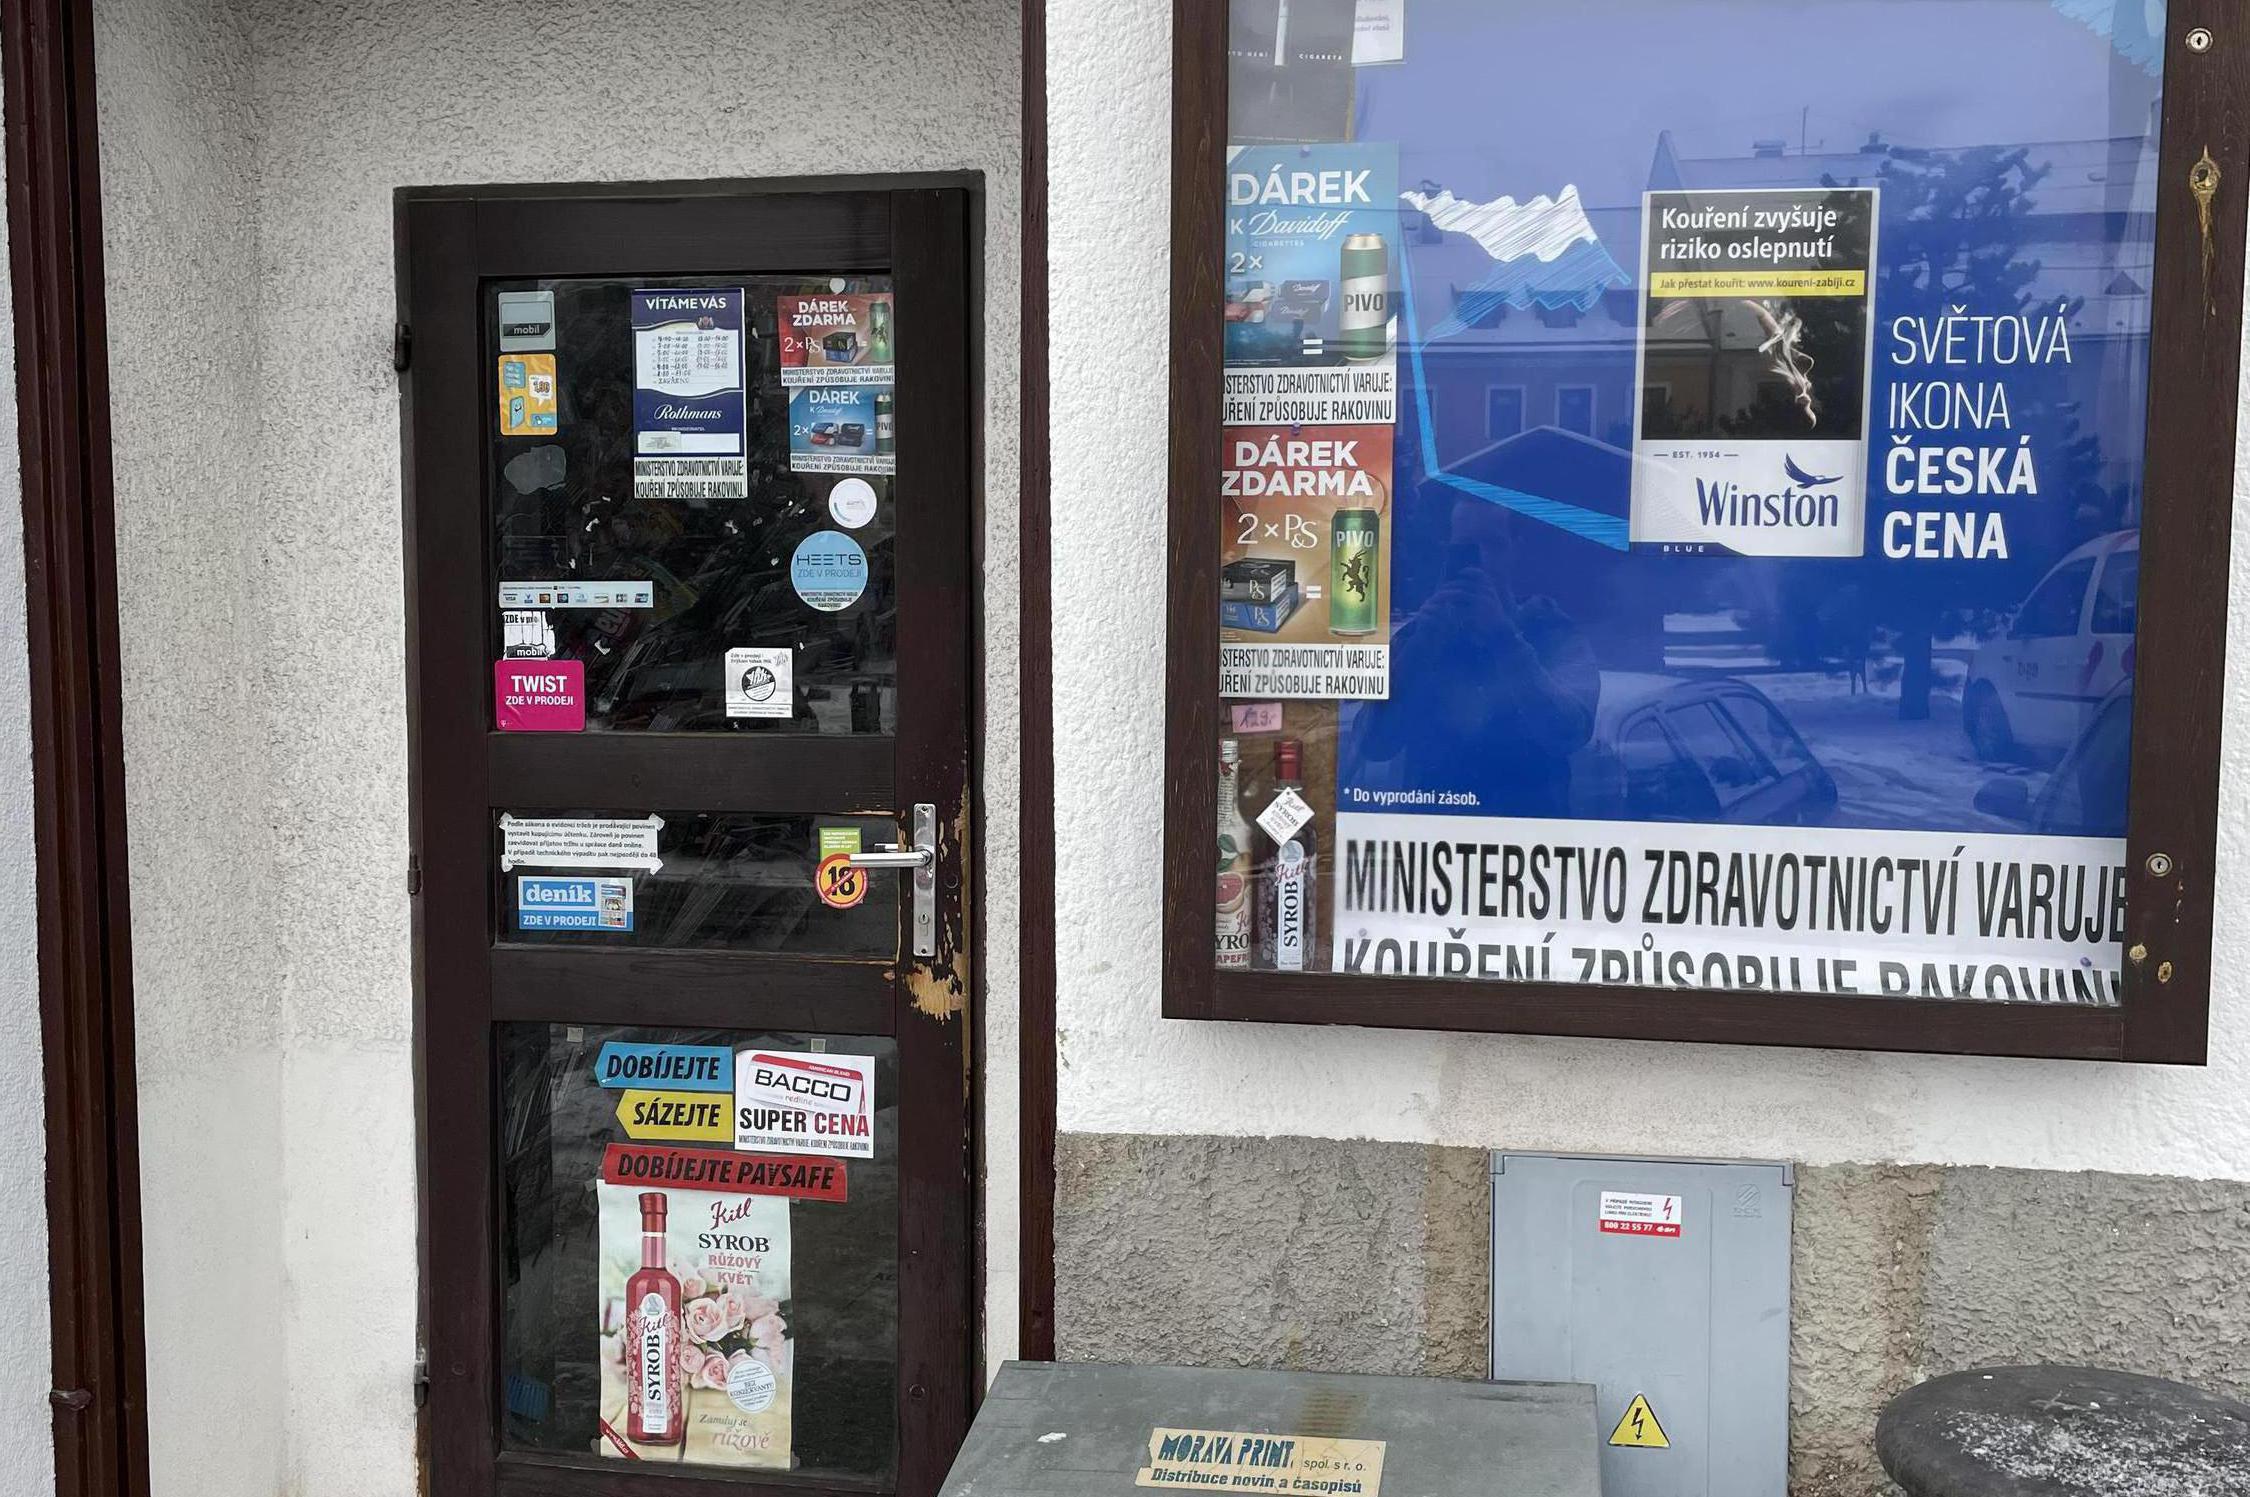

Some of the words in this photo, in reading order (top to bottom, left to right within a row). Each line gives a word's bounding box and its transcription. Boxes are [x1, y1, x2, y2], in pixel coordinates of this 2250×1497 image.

[1298, 53, 1343, 61] CIGARETA
[1230, 163, 1372, 206] DÁREK
[1230, 218, 1244, 235] K
[1248, 209, 1354, 240] Davidoff
[1661, 205, 1749, 230] Kouření
[1753, 204, 1838, 233] zvyšuje
[1660, 236, 1721, 260] riziko
[1727, 234, 1836, 264] oslepnutí
[1660, 279, 1675, 289] Jak
[1677, 278, 1712, 290] přestat
[645, 296, 698, 310] VÍTÁME
[699, 295, 727, 309] VÁS
[798, 298, 849, 314] DÁREK
[1344, 293, 1384, 312] PIVO
[513, 324, 540, 335] mobil
[792, 313, 857, 327] ZDARMA
[1891, 303, 2072, 365] SVĚTOVÁ
[1277, 367, 1350, 394] ZDRAVOTNICTVÍ
[1353, 372, 1393, 393] VARUJE:
[808, 387, 860, 405] DÁREK
[1259, 395, 1327, 422] ZPŮSOBUJE
[1331, 399, 1392, 421] RAKOVINU
[1889, 381, 2011, 430] IKONA
[653, 403, 723, 420] Rothmans
[1235, 434, 1359, 468] DÁREK
[1672, 451, 1693, 459] EST.
[1698, 451, 1720, 459] 1954
[635, 460, 676, 477] MINISTERSTVO
[676, 457, 720, 477] ZDRAVOTNICTVÍ
[1885, 434, 2038, 496] ČESKÁ
[635, 478, 666, 498] KOUŘENÍ
[666, 477, 706, 498] ZPŮSOBUJE
[1221, 470, 1374, 496] ZDARMA
[1695, 476, 1839, 528] Winston
[1335, 530, 1374, 548] PIVO
[1882, 510, 2009, 560] CENA
[796, 553, 862, 566] HEETS
[1663, 545, 1704, 553] BLUE
[797, 568, 815, 578] ZDE
[816, 568, 823, 578] V
[825, 568, 862, 578] PRODEJI
[505, 614, 519, 624] ZDE
[1272, 644, 1344, 670] ZDRAVOTNICTVÍ
[1346, 649, 1385, 669] VARUJE:
[510, 675, 568, 693] TWIST
[1255, 669, 1322, 694] ZPŮSOBUJE
[1325, 675, 1384, 695] RAKOVINU
[505, 696, 525, 706] ZDE
[525, 696, 533, 705] V
[535, 695, 574, 706] PRODEJI
[1353, 787, 1370, 802] Do
[1372, 789, 1436, 806] vyprodání
[1438, 790, 1480, 806] zásob.
[525, 884, 593, 903] deník
[828, 866, 855, 896] 18
[1345, 839, 1628, 924] MINISTERSTVO
[1641, 845, 1967, 936] ZDRAVOTNICTVÍ
[1977, 860, 2127, 944] VARUJE
[523, 915, 543, 926] ZDE
[545, 915, 552, 926] V
[553, 915, 596, 927] PRODEJI
[1283, 880, 1298, 947] SYROB
[606, 1050, 721, 1081] DOBÍJEJTE
[754, 1068, 851, 1102] BACCO
[632, 1098, 722, 1127] SÁZEJTE
[739, 1107, 807, 1133] SUPER
[814, 1112, 870, 1137] CENA
[617, 1151, 735, 1185] DOBÍJEJTE
[737, 1160, 836, 1191] PAYSAFE
[709, 1197, 753, 1231] Kitl
[1620, 1222, 1630, 1230] 22
[1632, 1223, 1642, 1231] 55
[698, 1233, 771, 1253] SYROB
[708, 1252, 763, 1270] RŮŽOVÝ
[717, 1270, 754, 1286] KVĚT
[640, 1313, 668, 1338] Kitl
[646, 1333, 661, 1401] SYROB
[1158, 1433, 1232, 1465] MORAVA
[1303, 1458, 1330, 1471] spol.
[1333, 1461, 1341, 1470] s
[1343, 1460, 1351, 1470] r.
[1355, 1461, 1367, 1472] o.
[1151, 1467, 1228, 1486] Distribuce
[1232, 1474, 1275, 1489] novin
[1280, 1478, 1288, 1489] a
[1292, 1476, 1362, 1494] časopisů
